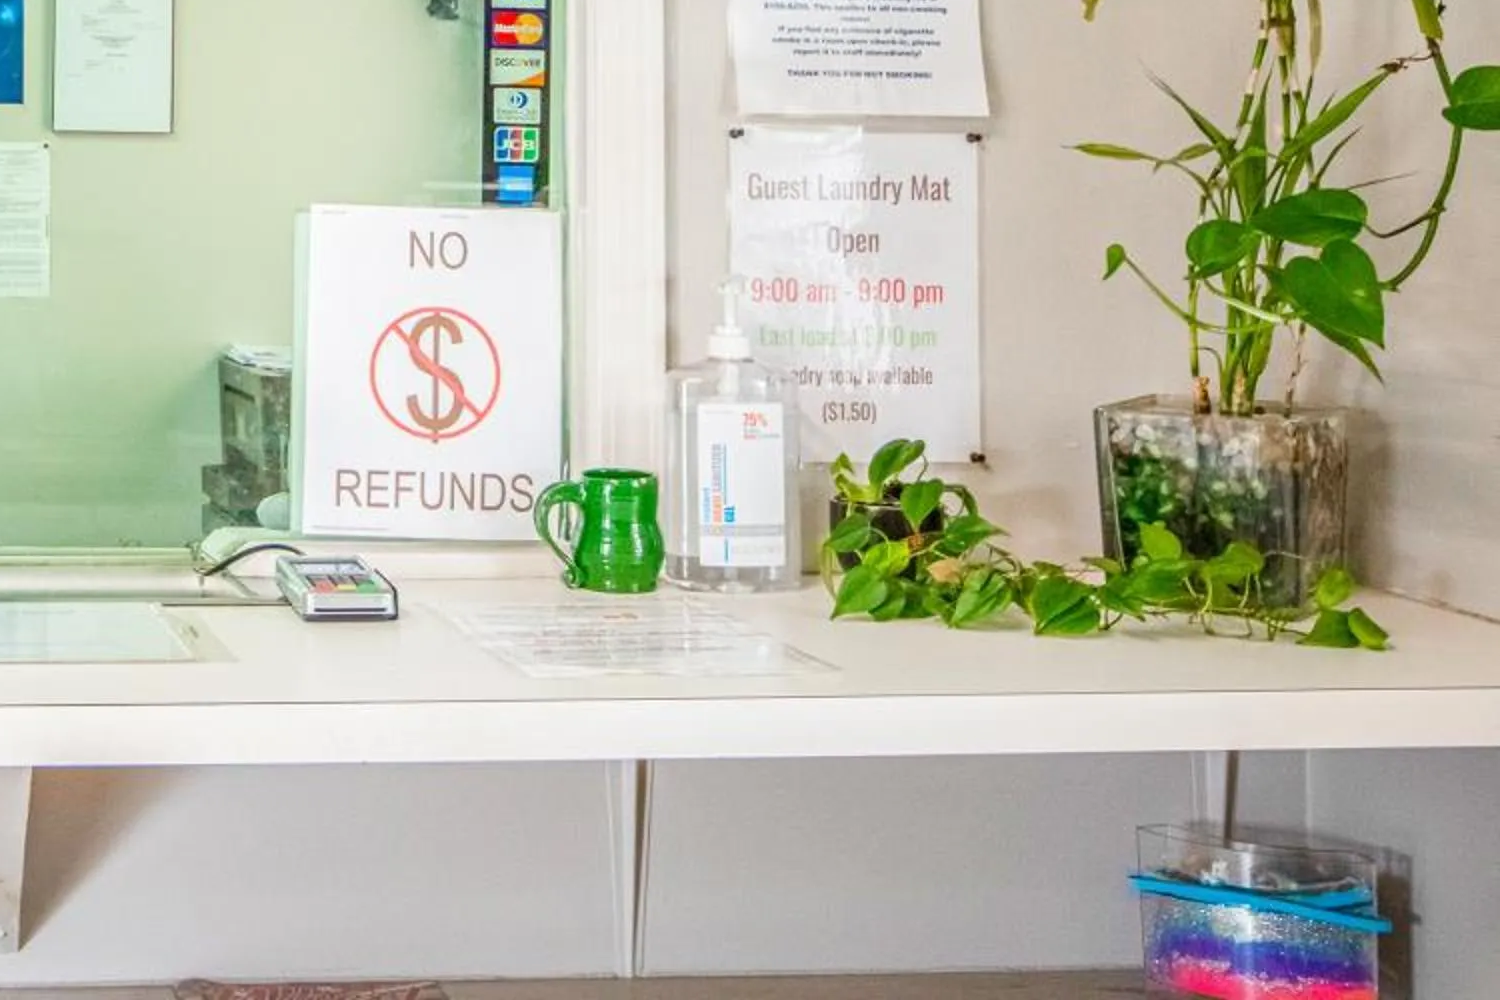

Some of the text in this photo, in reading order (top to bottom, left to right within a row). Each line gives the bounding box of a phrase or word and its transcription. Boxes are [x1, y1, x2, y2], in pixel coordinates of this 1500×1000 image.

[495, 57, 541, 68] DISCVER
[747, 173, 951, 205] Guest Laundry Mat
[409, 231, 468, 270] NO
[827, 226, 880, 257] Open
[751, 277, 798, 303] 9:00
[806, 282, 837, 302] am
[912, 284, 943, 308] pm
[759, 325, 794, 347] Last
[910, 331, 937, 352] pm
[823, 402, 877, 424] ($1.50)
[335, 468, 534, 513] REFUNDS
